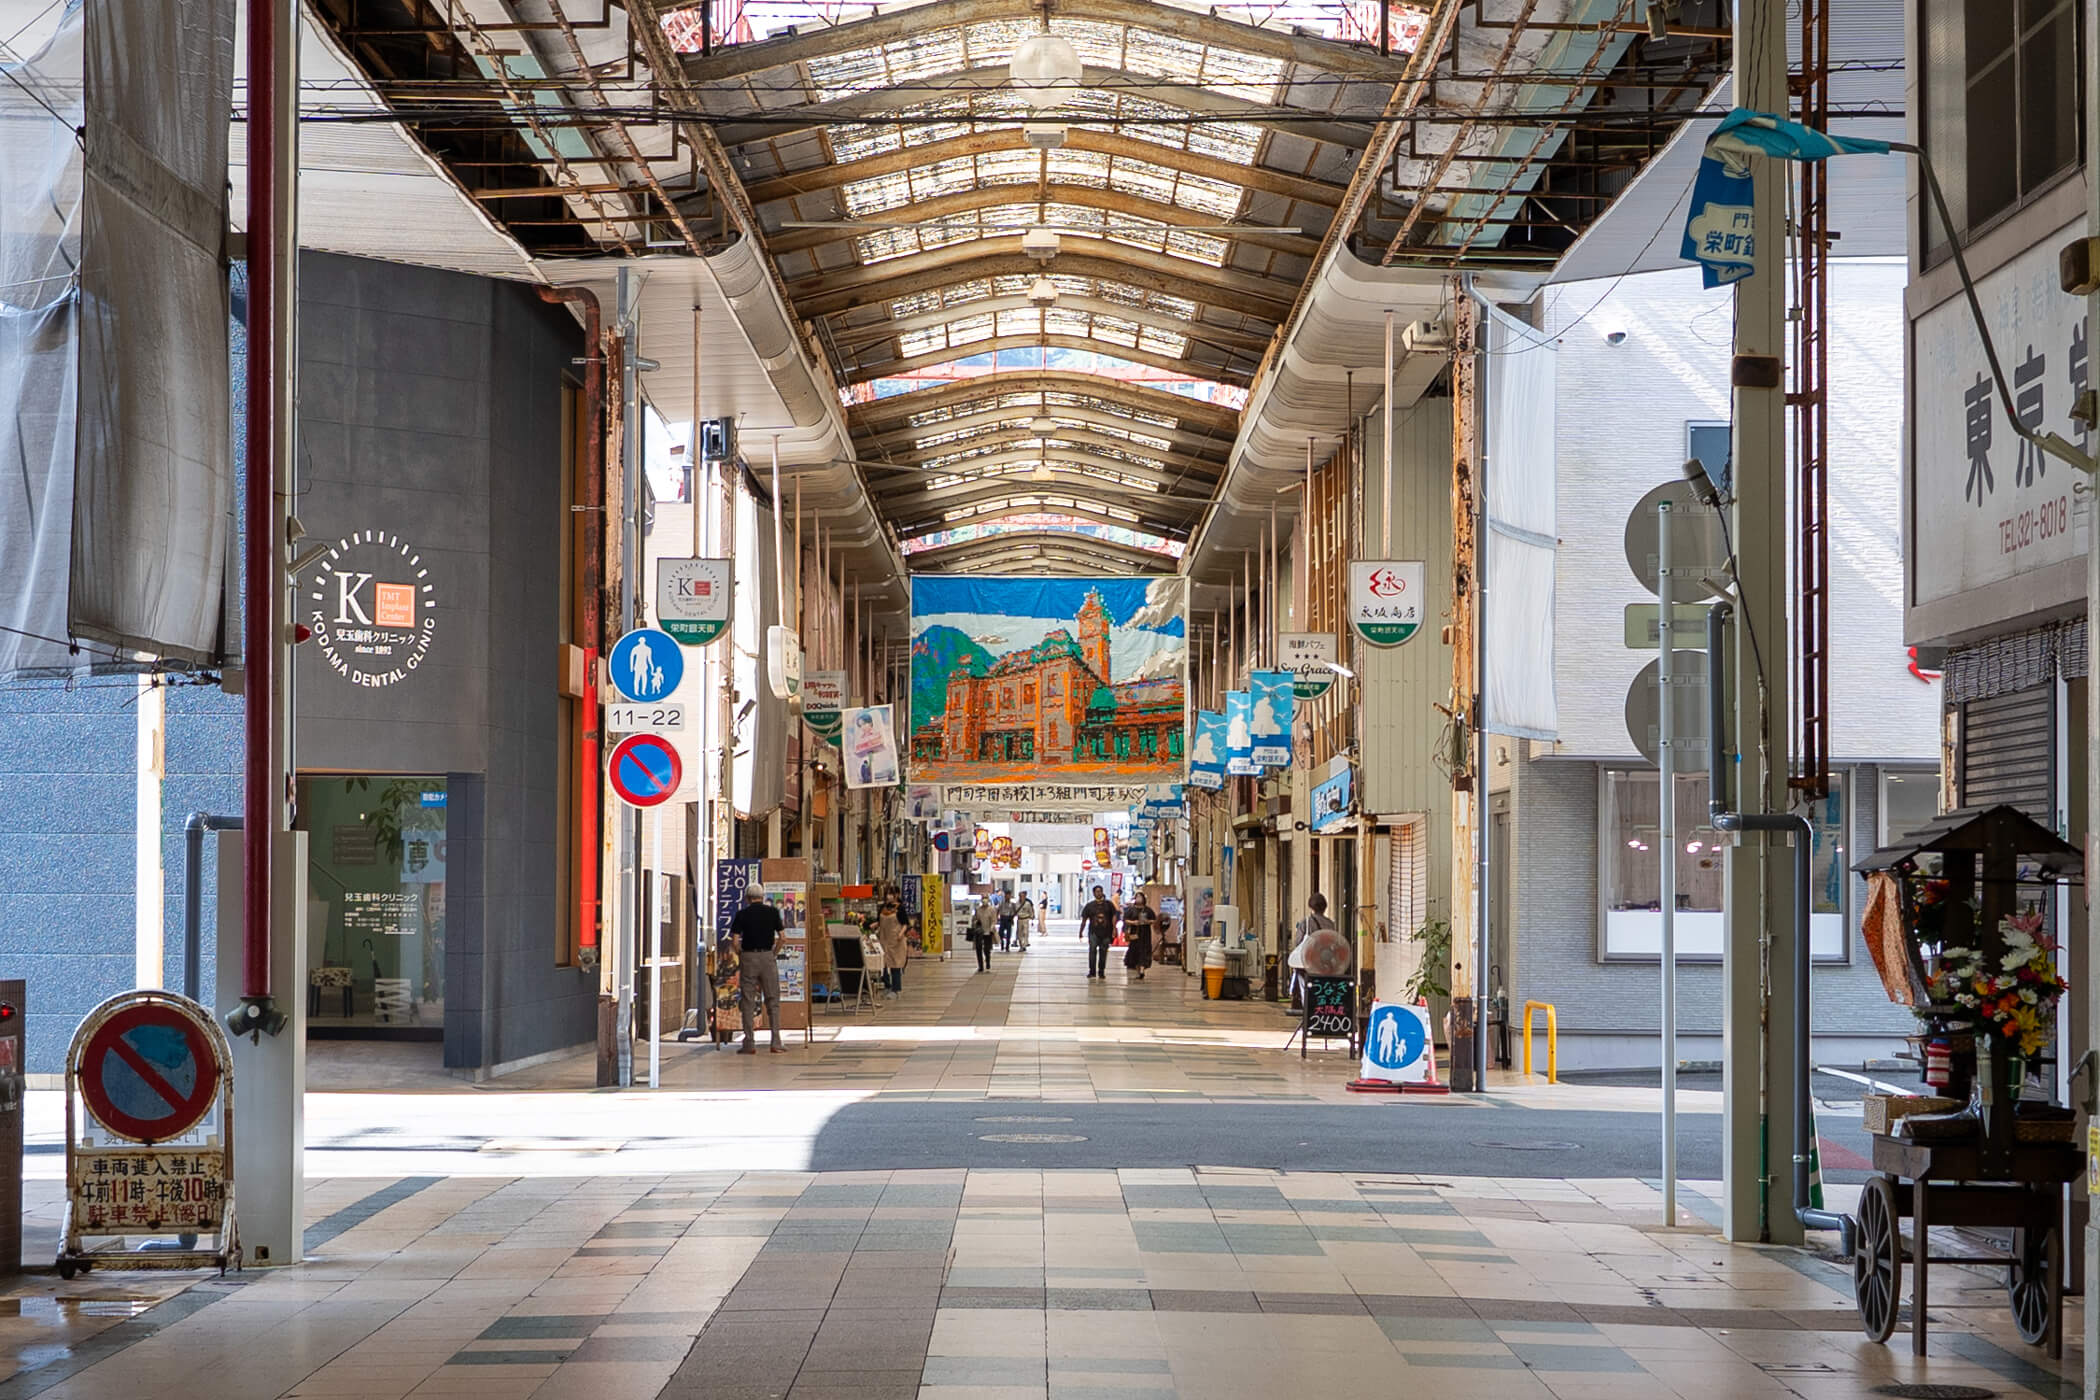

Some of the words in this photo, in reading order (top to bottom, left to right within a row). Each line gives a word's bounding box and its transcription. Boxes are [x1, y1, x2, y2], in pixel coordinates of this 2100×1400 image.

[1965, 316, 2088, 507] 東京
[334, 571, 372, 624] K
[678, 578, 693, 596] K
[312, 610, 349, 677] KODAMA
[352, 668, 407, 687] DENTAL
[407, 617, 436, 670] CLINIC
[612, 710, 682, 727] 11-22
[719, 864, 733, 941] マチテラス
[1308, 1015, 1352, 1032] 2400
[91, 1156, 206, 1177] 車両進入禁止
